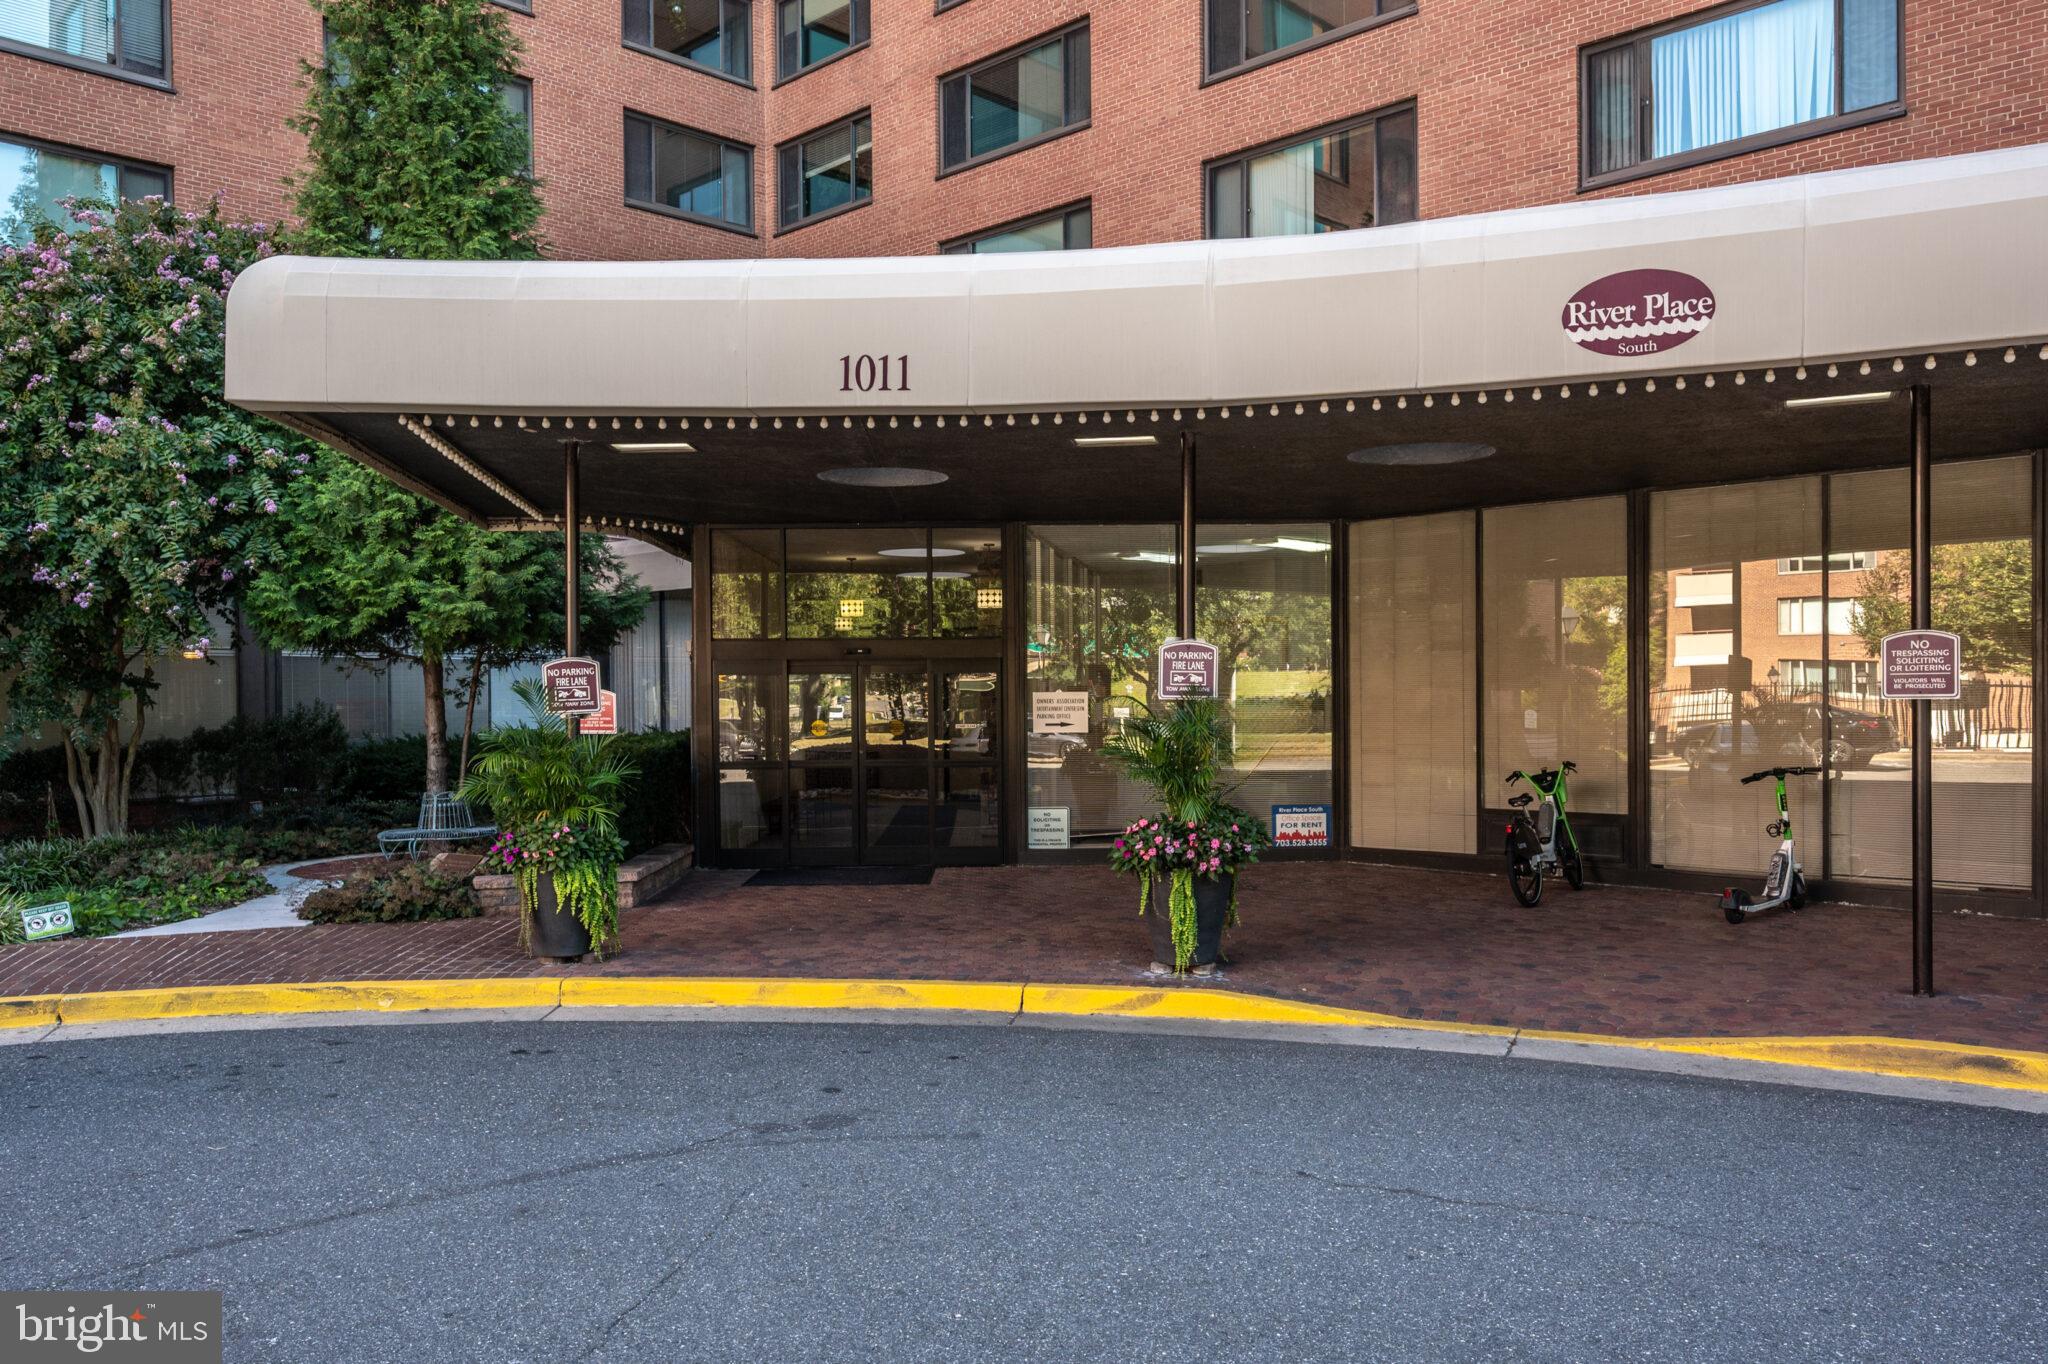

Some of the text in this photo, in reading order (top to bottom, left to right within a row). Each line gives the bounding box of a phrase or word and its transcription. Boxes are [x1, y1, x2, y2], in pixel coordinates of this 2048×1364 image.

[1567, 292, 1713, 326] River Place
[1617, 340, 1657, 354] South
[839, 354, 911, 392] 1011
[1910, 640, 1929, 649] NO
[1164, 651, 1213, 660] NO PARKING
[1891, 649, 1949, 657] TRESPASSING
[1172, 661, 1205, 670] FIRE LANE
[1905, 664, 1951, 672] LOITERING
[547, 667, 595, 677] NO PARKING
[556, 677, 588, 686] FIRE LANE
[1276, 839, 1327, 847] 703.528.3555
